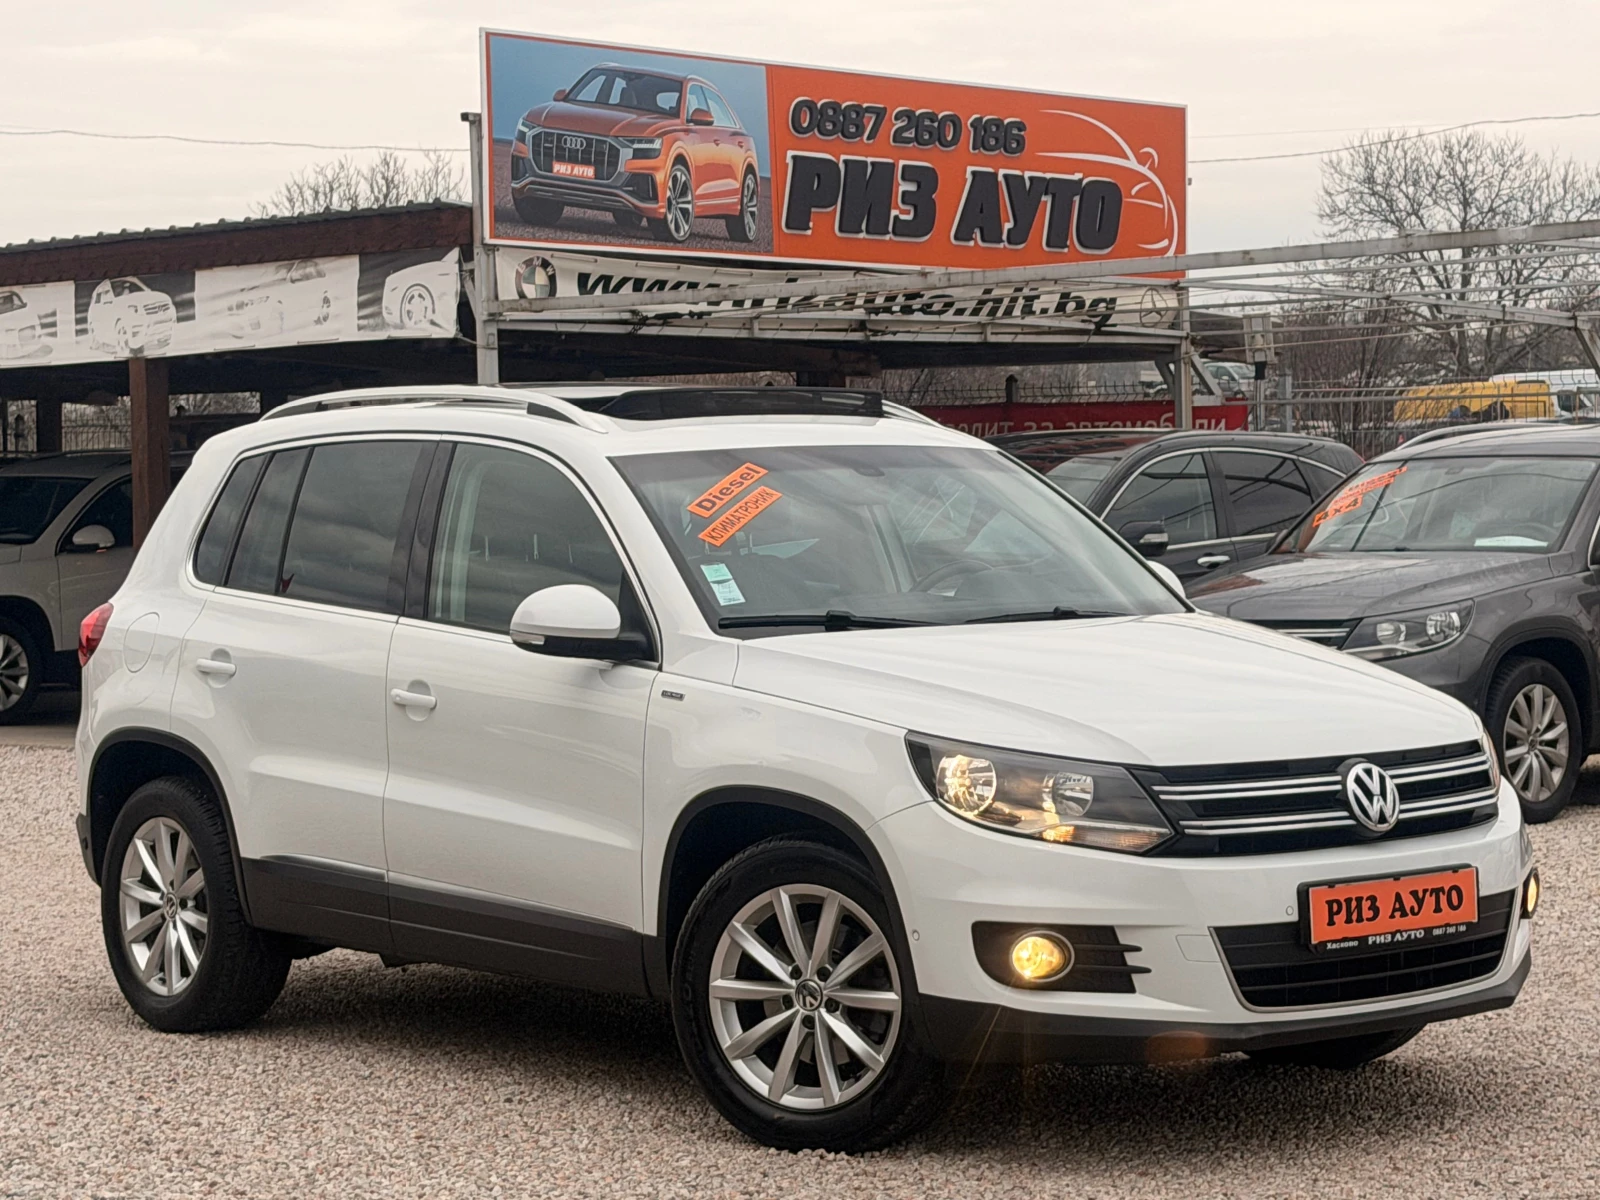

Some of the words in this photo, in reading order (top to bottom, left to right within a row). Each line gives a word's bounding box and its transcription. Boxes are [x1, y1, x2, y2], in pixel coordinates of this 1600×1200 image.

[789, 97, 887, 144] 0887
[890, 107, 962, 150] 260
[968, 114, 1027, 157] 186
[782, 150, 939, 241] РИЗ
[950, 166, 1123, 255] АУТО
[695, 466, 762, 512] Diesel
[705, 488, 776, 542] КЛИМАТРОНИК
[1325, 894, 1381, 927] РИЗ
[1388, 884, 1464, 920] АУТО
[1367, 933, 1392, 945] РИЗ
[1393, 929, 1425, 942] АУТО
